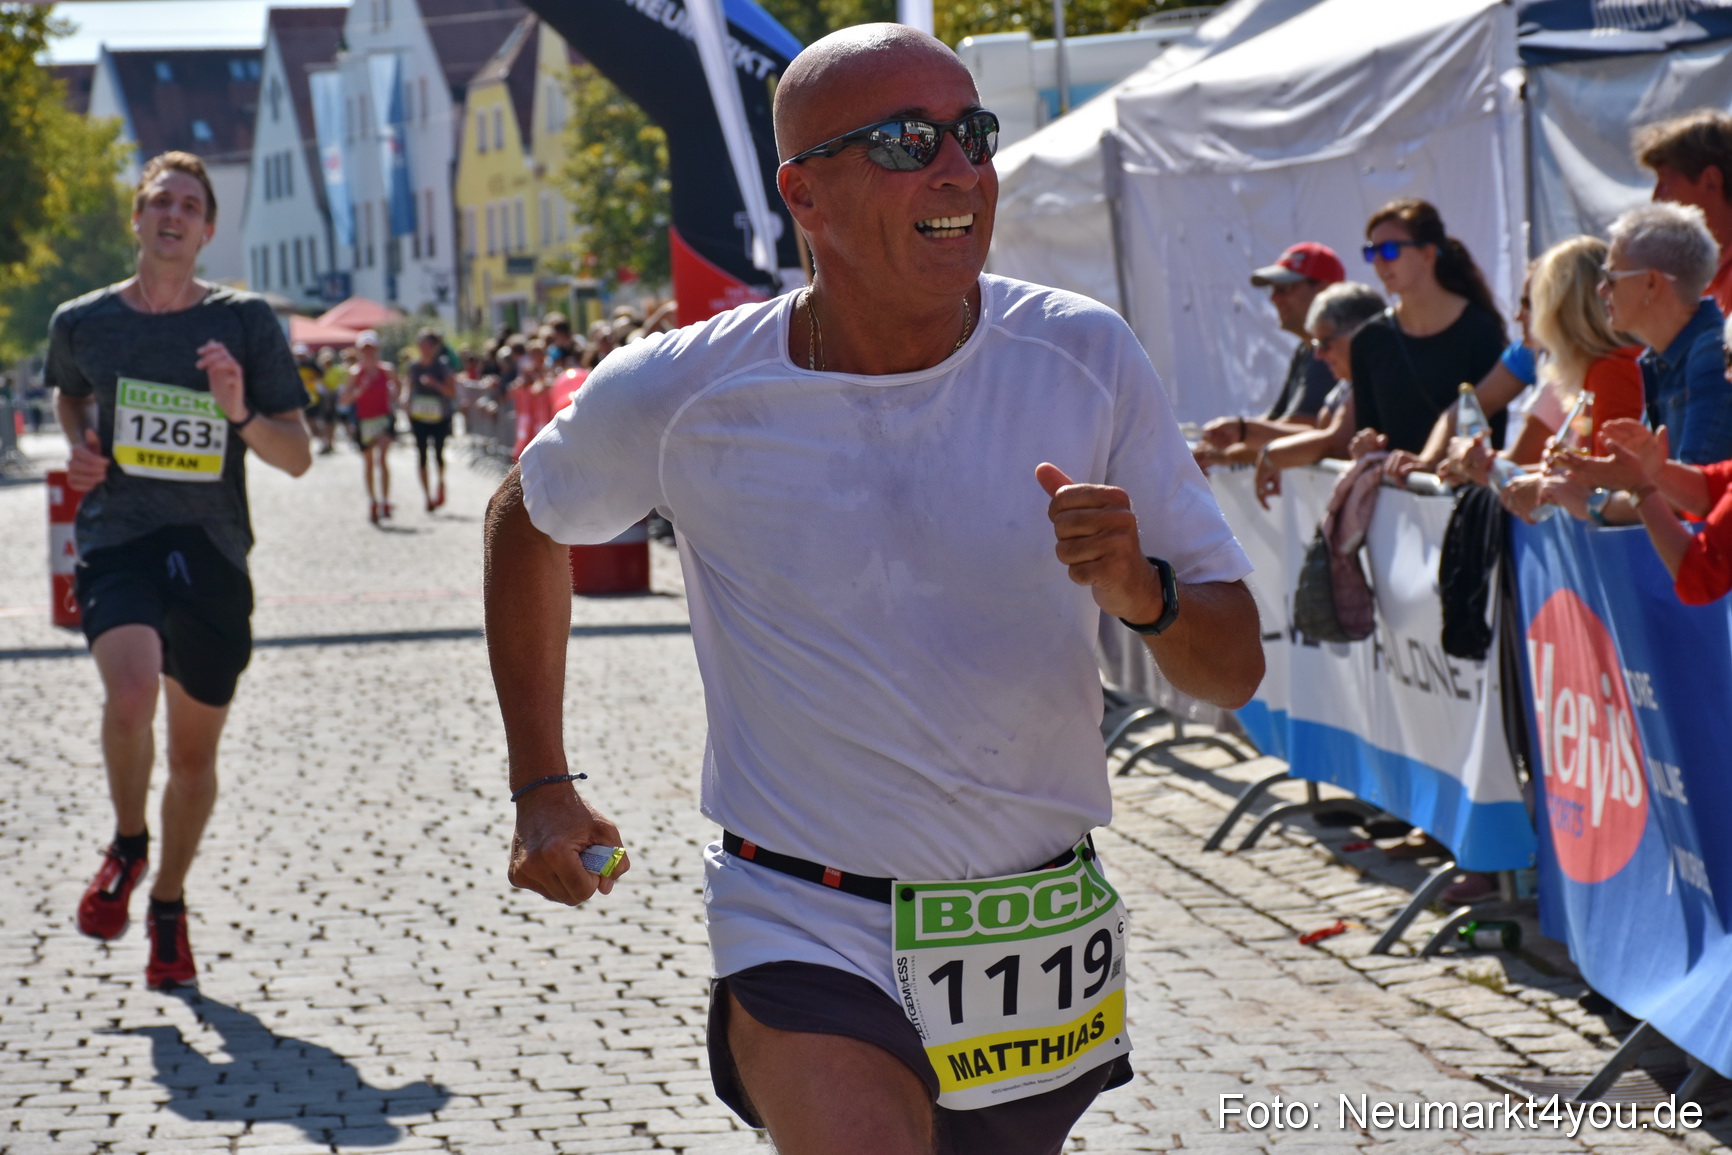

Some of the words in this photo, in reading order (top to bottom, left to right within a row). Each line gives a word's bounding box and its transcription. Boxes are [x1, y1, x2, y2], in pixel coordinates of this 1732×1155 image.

[127, 385, 214, 415] BOCK
[130, 414, 212, 449] 1263
[136, 451, 198, 469] STEFAN
[1527, 638, 1643, 828] Hervis
[916, 872, 1110, 938] BOCK
[928, 928, 1113, 1025] 1119
[947, 1012, 1105, 1082] MATTHIAS
